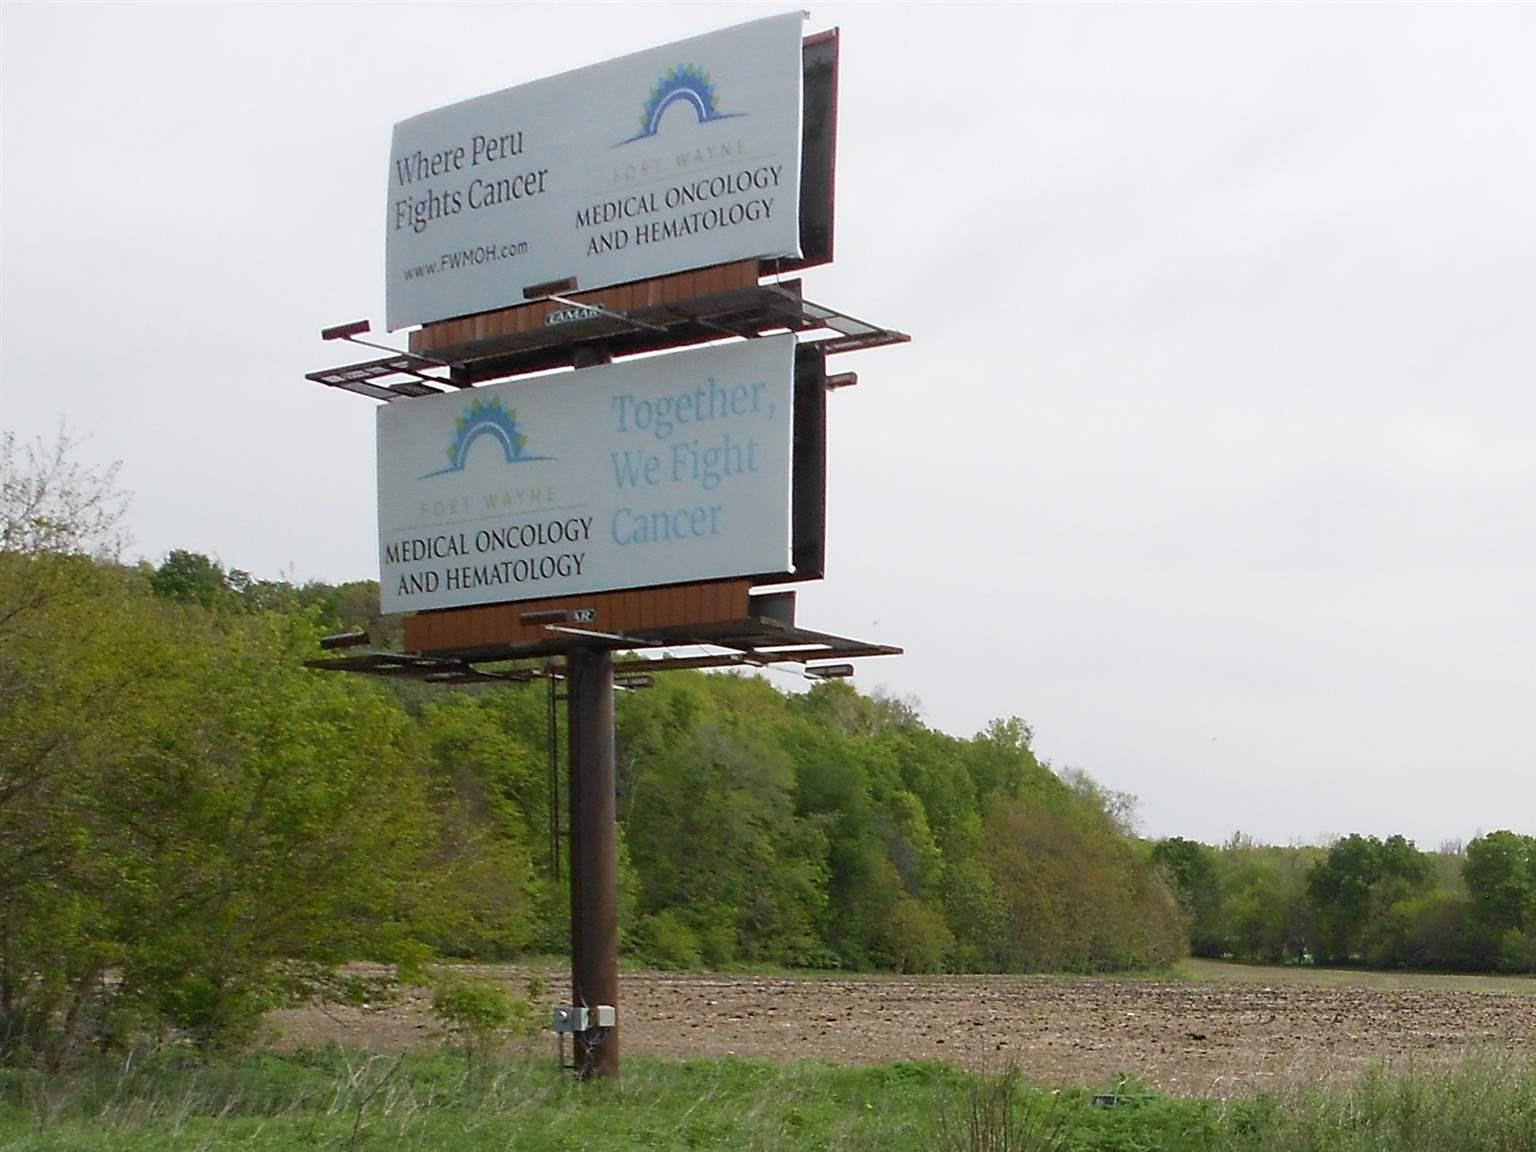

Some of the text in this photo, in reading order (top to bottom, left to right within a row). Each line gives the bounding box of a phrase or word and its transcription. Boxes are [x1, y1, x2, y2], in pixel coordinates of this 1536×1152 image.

[396, 129, 525, 187] Where Peru
[676, 138, 746, 168] WAYNE
[394, 167, 549, 233] Fights Cancer
[575, 165, 784, 230] MEDICAL ONCOLOGY
[586, 198, 775, 256] AND HEMATOLOGY
[403, 240, 529, 281] www.FWMOH.com
[610, 377, 778, 440] Together,
[609, 434, 760, 490] We Fight
[484, 487, 556, 510] WAYNE
[610, 503, 724, 546] Cancer
[385, 516, 594, 565] MEDICAL ONCOLOGY
[398, 552, 586, 596] AND HEMATOLOGY
